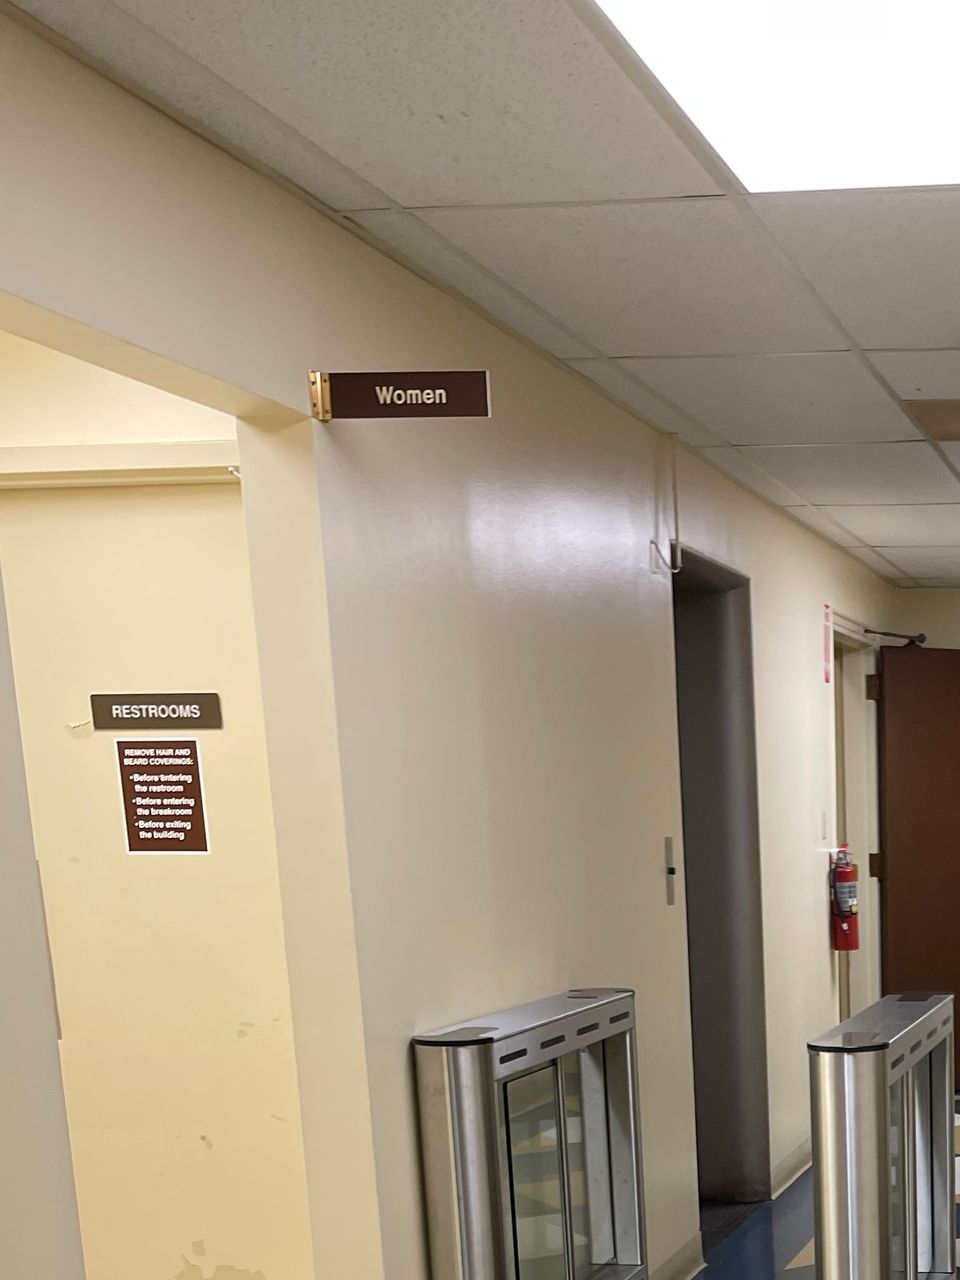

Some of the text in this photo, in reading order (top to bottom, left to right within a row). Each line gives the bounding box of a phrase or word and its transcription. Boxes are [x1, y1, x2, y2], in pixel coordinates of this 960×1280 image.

[375, 386, 447, 405] Women
[111, 705, 201, 718] RESTROOMS
[124, 748, 191, 756] REMOVE HAIR AND
[123, 758, 149, 766] BEARD
[133, 773, 193, 783] Before entering
[148, 785, 184, 793] restroom
[135, 797, 195, 807] Before entering
[150, 808, 193, 816] breakroom
[138, 820, 192, 830] Before exiting
[139, 831, 185, 841] the building
